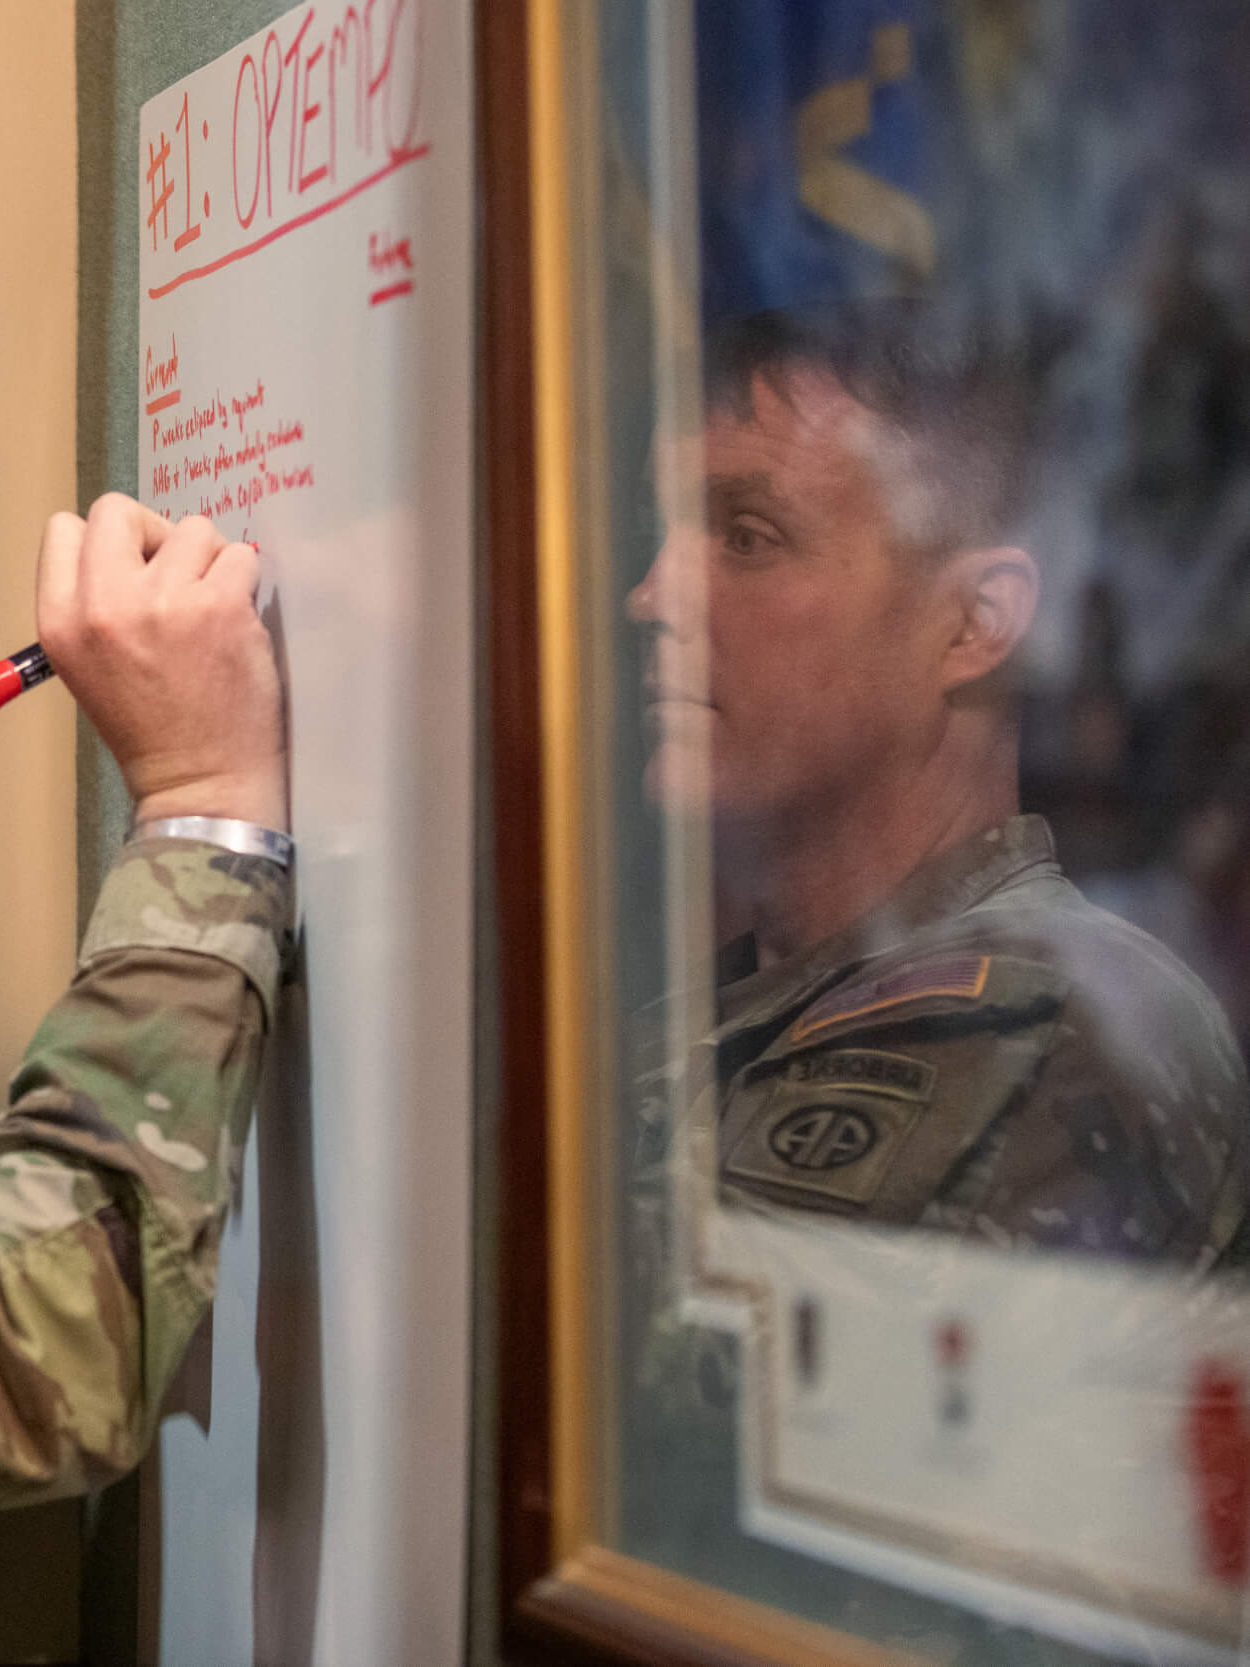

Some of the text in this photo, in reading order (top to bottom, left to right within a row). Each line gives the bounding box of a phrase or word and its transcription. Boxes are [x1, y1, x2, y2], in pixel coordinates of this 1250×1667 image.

[146, 0, 425, 253] #1: OPTEMPO
[217, 388, 228, 430] by
